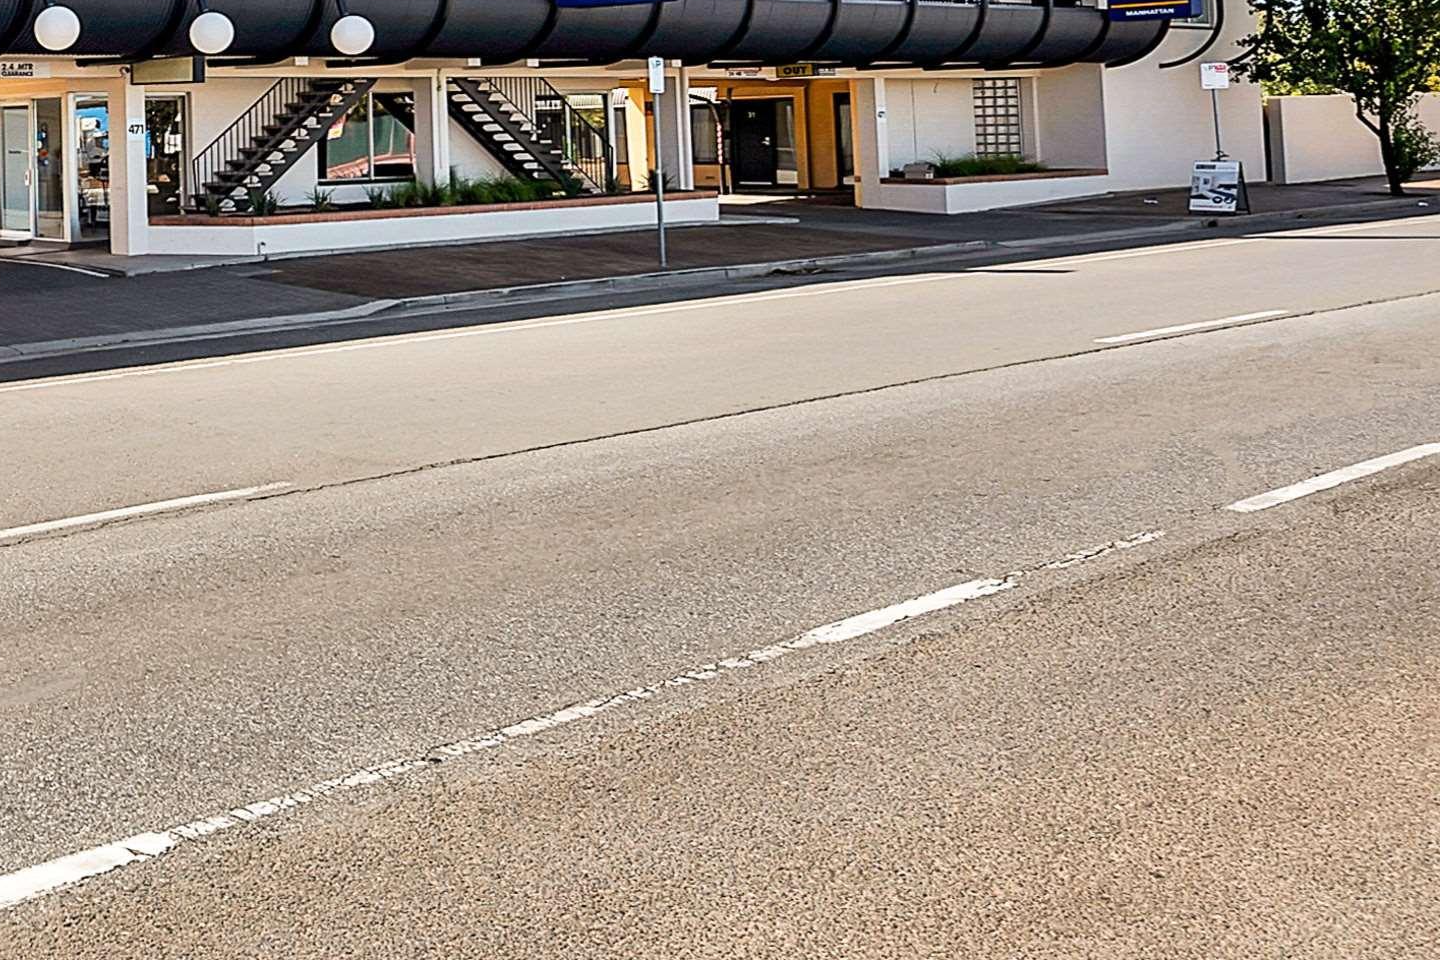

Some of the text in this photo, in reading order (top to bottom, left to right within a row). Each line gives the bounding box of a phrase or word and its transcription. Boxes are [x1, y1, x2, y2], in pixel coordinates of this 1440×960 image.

[1125, 8, 1175, 16] MANHATTAN
[783, 66, 807, 75] OUT
[128, 124, 144, 135] 471
